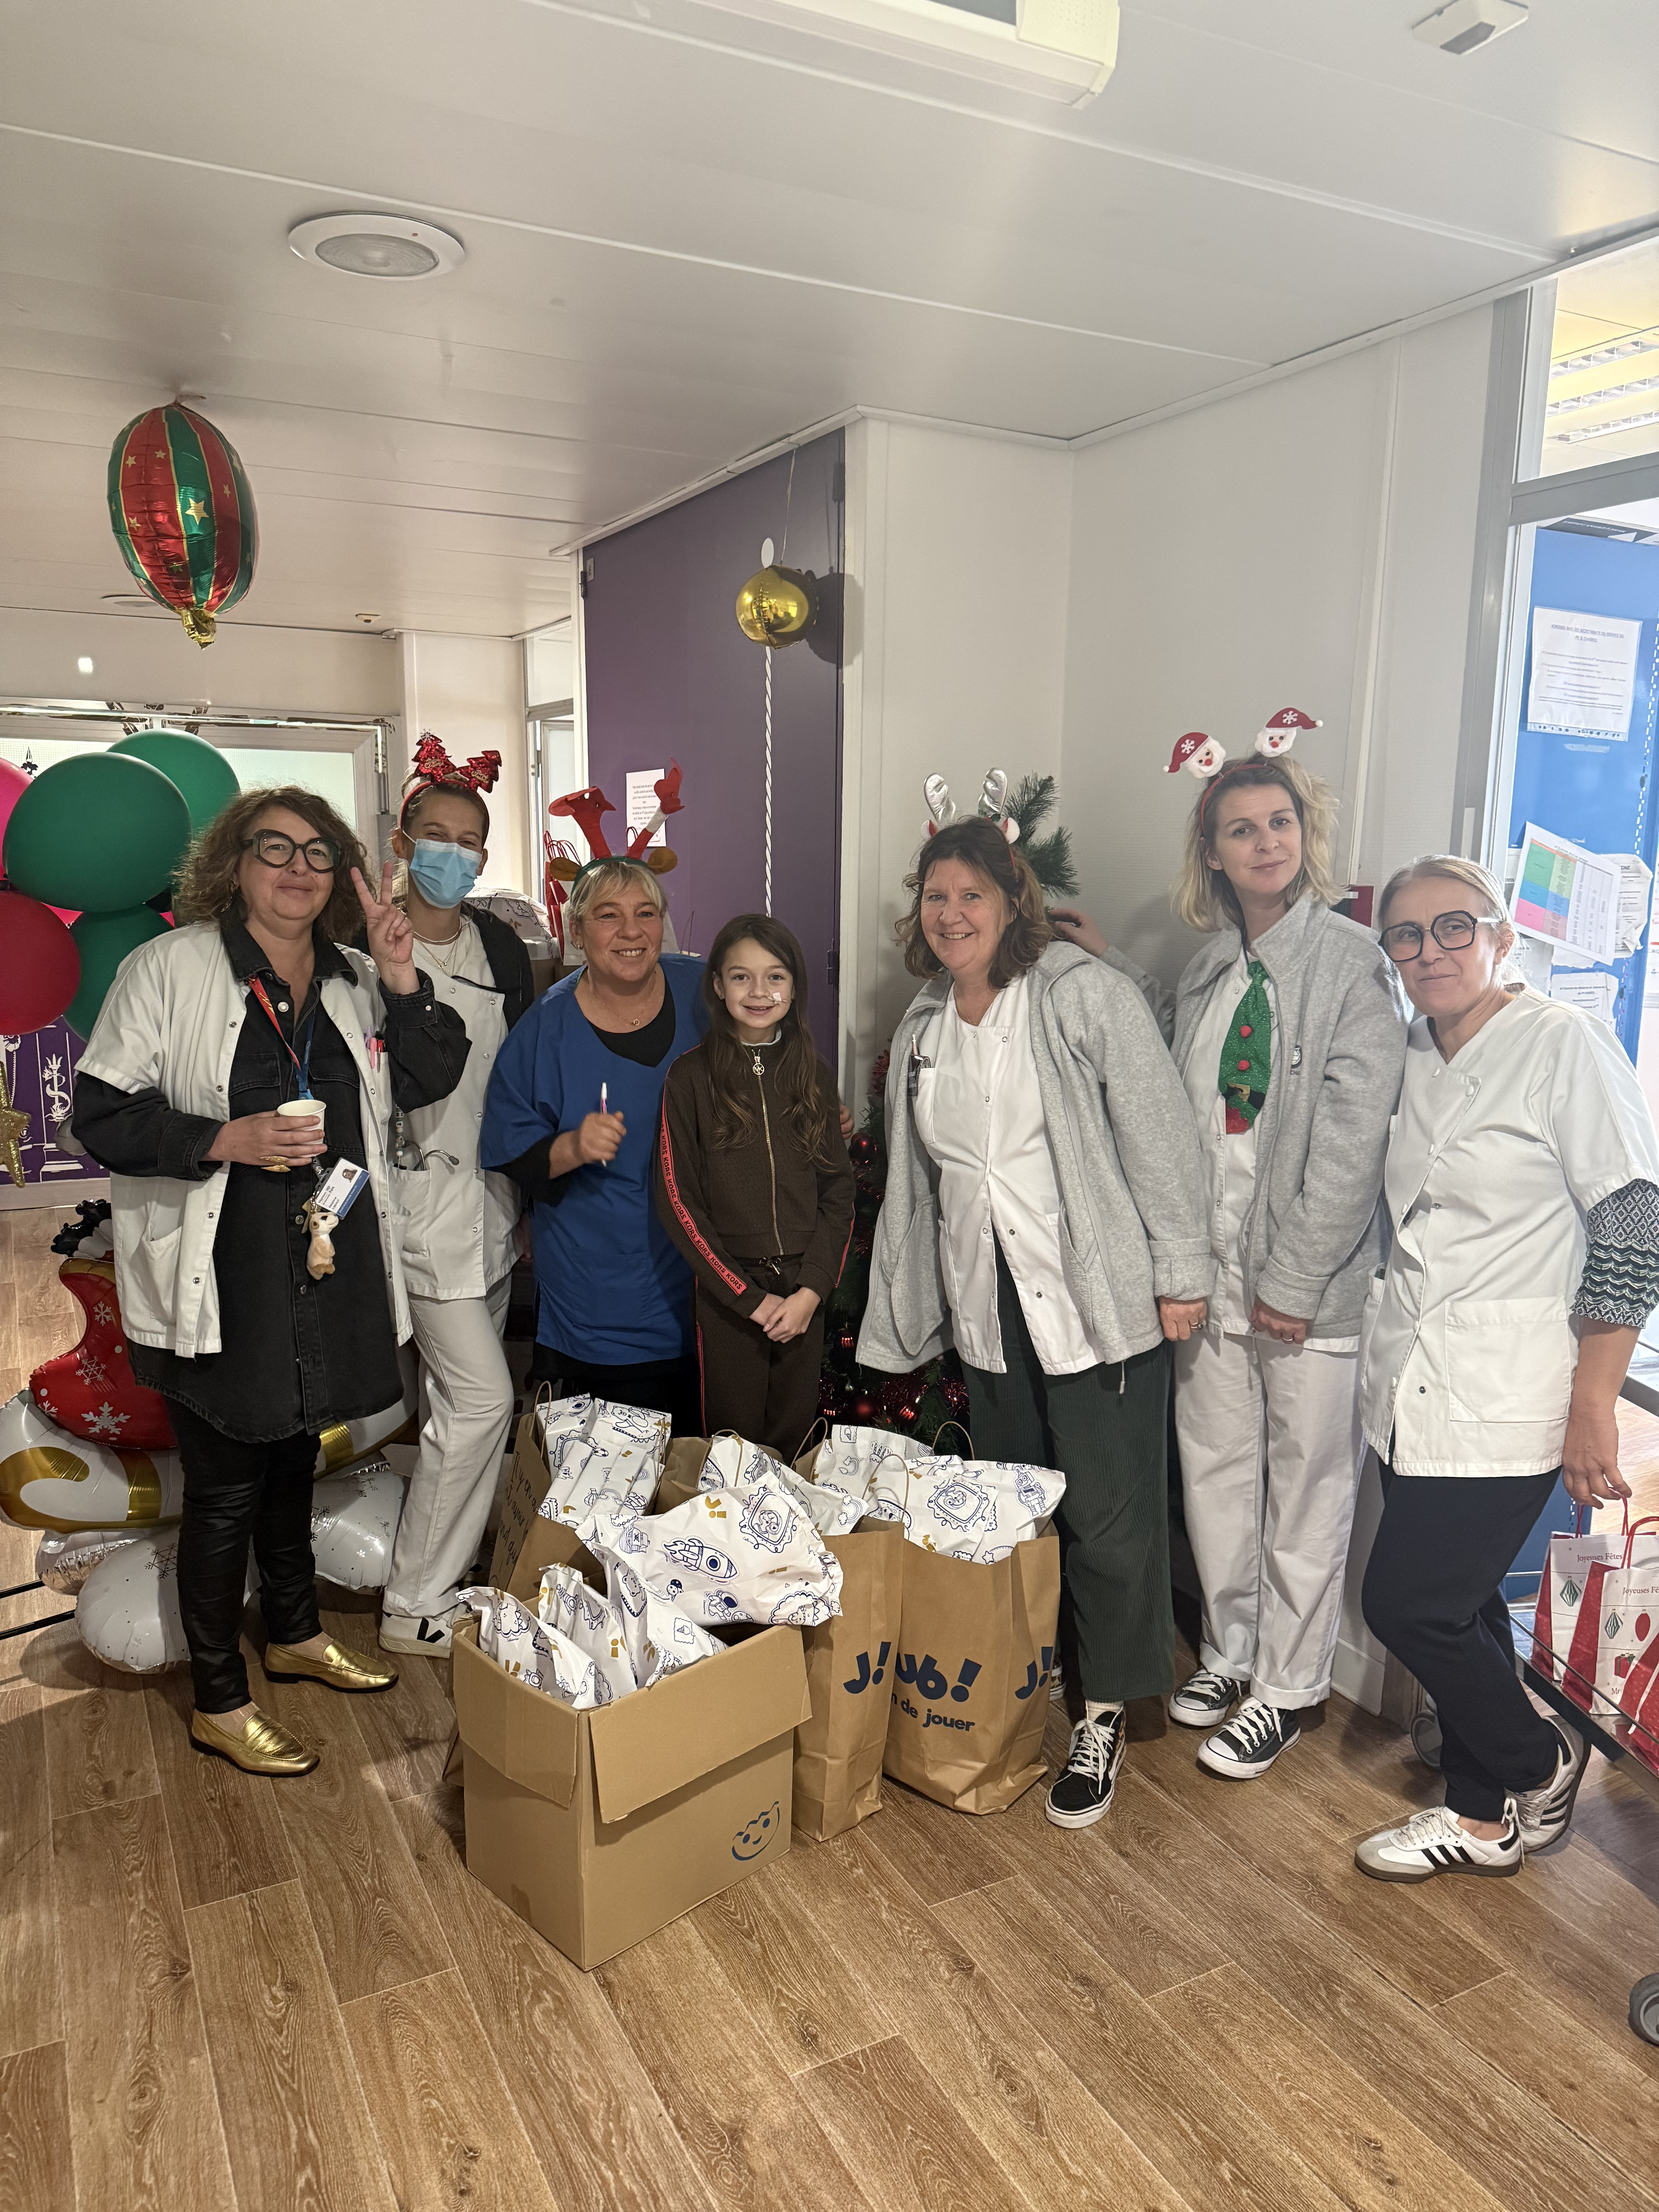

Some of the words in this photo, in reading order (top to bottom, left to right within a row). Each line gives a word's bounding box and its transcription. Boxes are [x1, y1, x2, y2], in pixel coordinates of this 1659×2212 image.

[668, 1179, 676, 1199] KORS
[674, 1200, 686, 1219] KORS
[684, 1220, 697, 1239] KORS
[696, 1239, 711, 1257] KORS
[710, 1257, 726, 1273] KORS
[726, 1273, 742, 1290] KORS
[1577, 1554, 1603, 1563] Joyeuses
[1623, 1587, 1649, 1595] Joyeuses
[843, 1641, 891, 1694] J!
[901, 1698, 918, 1718] de
[922, 1708, 975, 1732] jouer
